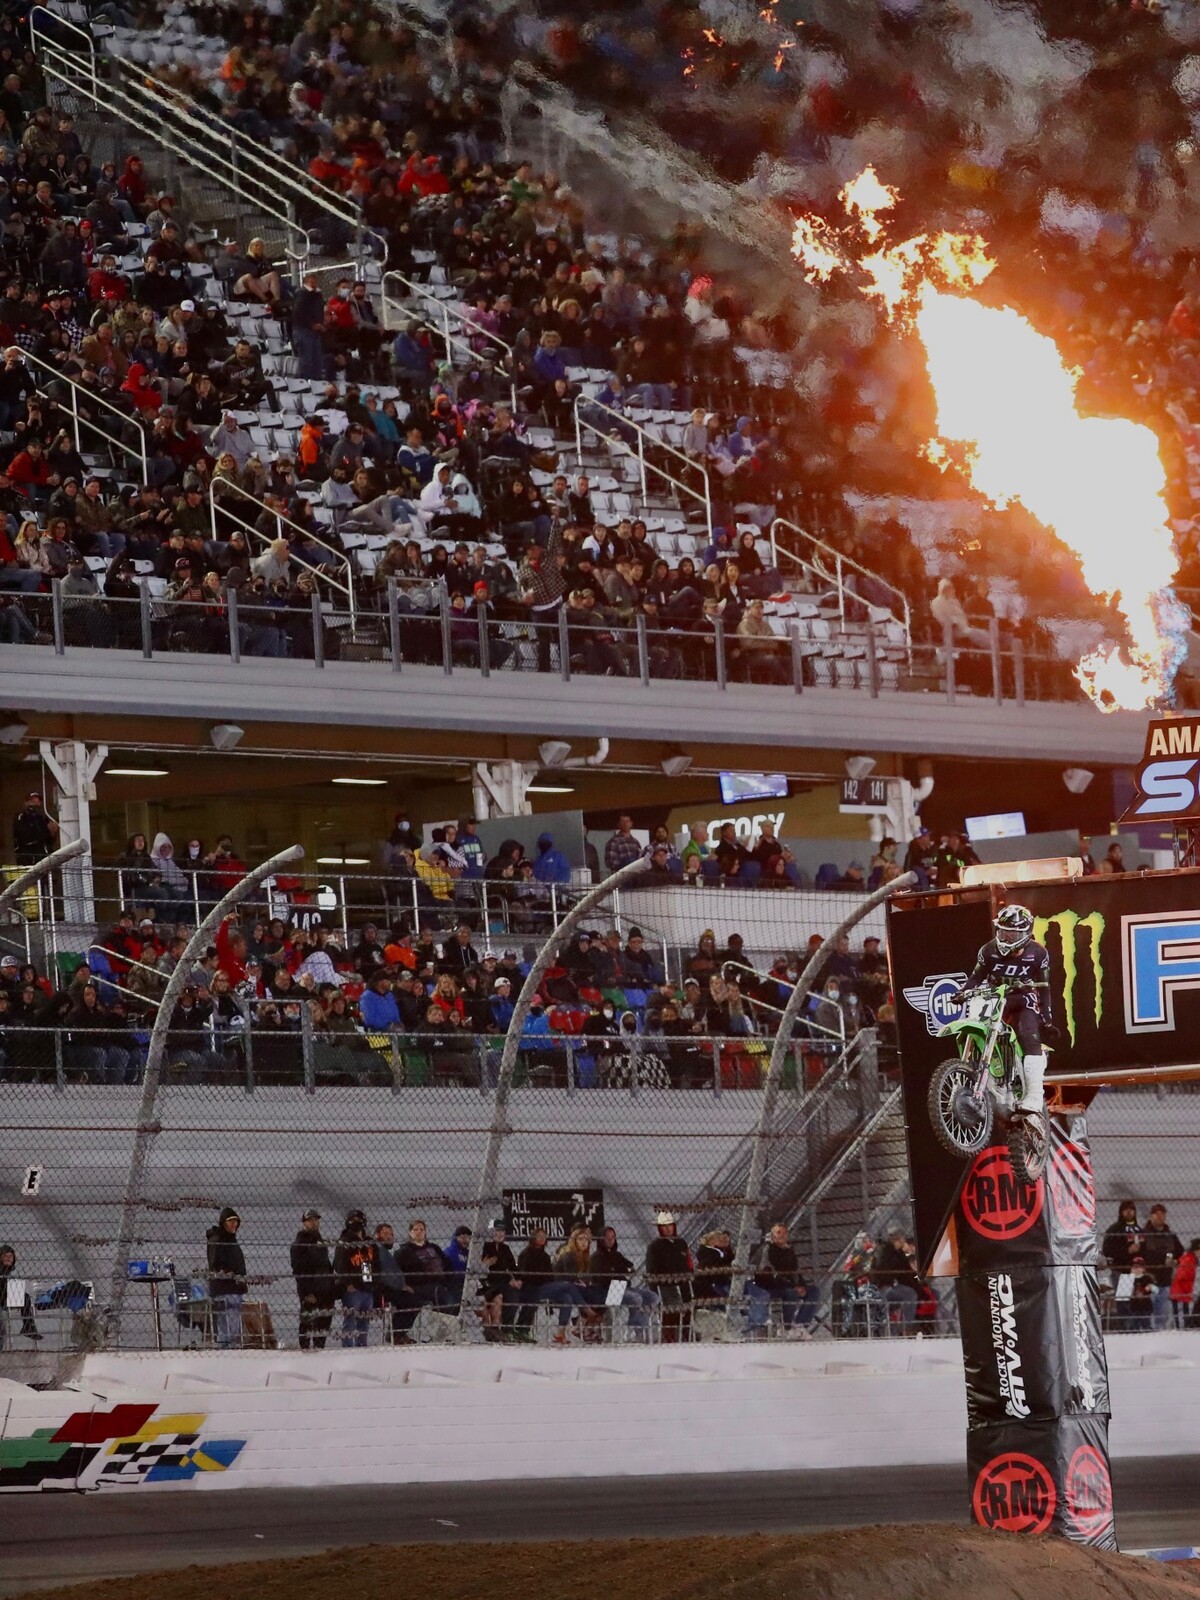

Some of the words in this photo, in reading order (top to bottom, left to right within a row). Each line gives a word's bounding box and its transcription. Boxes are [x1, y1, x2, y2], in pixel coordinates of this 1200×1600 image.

[843, 780, 859, 800] 142
[871, 780, 885, 800] 141
[992, 963, 1031, 976] FOX
[28, 1170, 38, 1190] E
[511, 1192, 531, 1214] ALL
[512, 1216, 566, 1238] SECTIONS
[988, 1276, 1004, 1350] MOUNTAIN
[996, 1352, 1011, 1398] ROCKY
